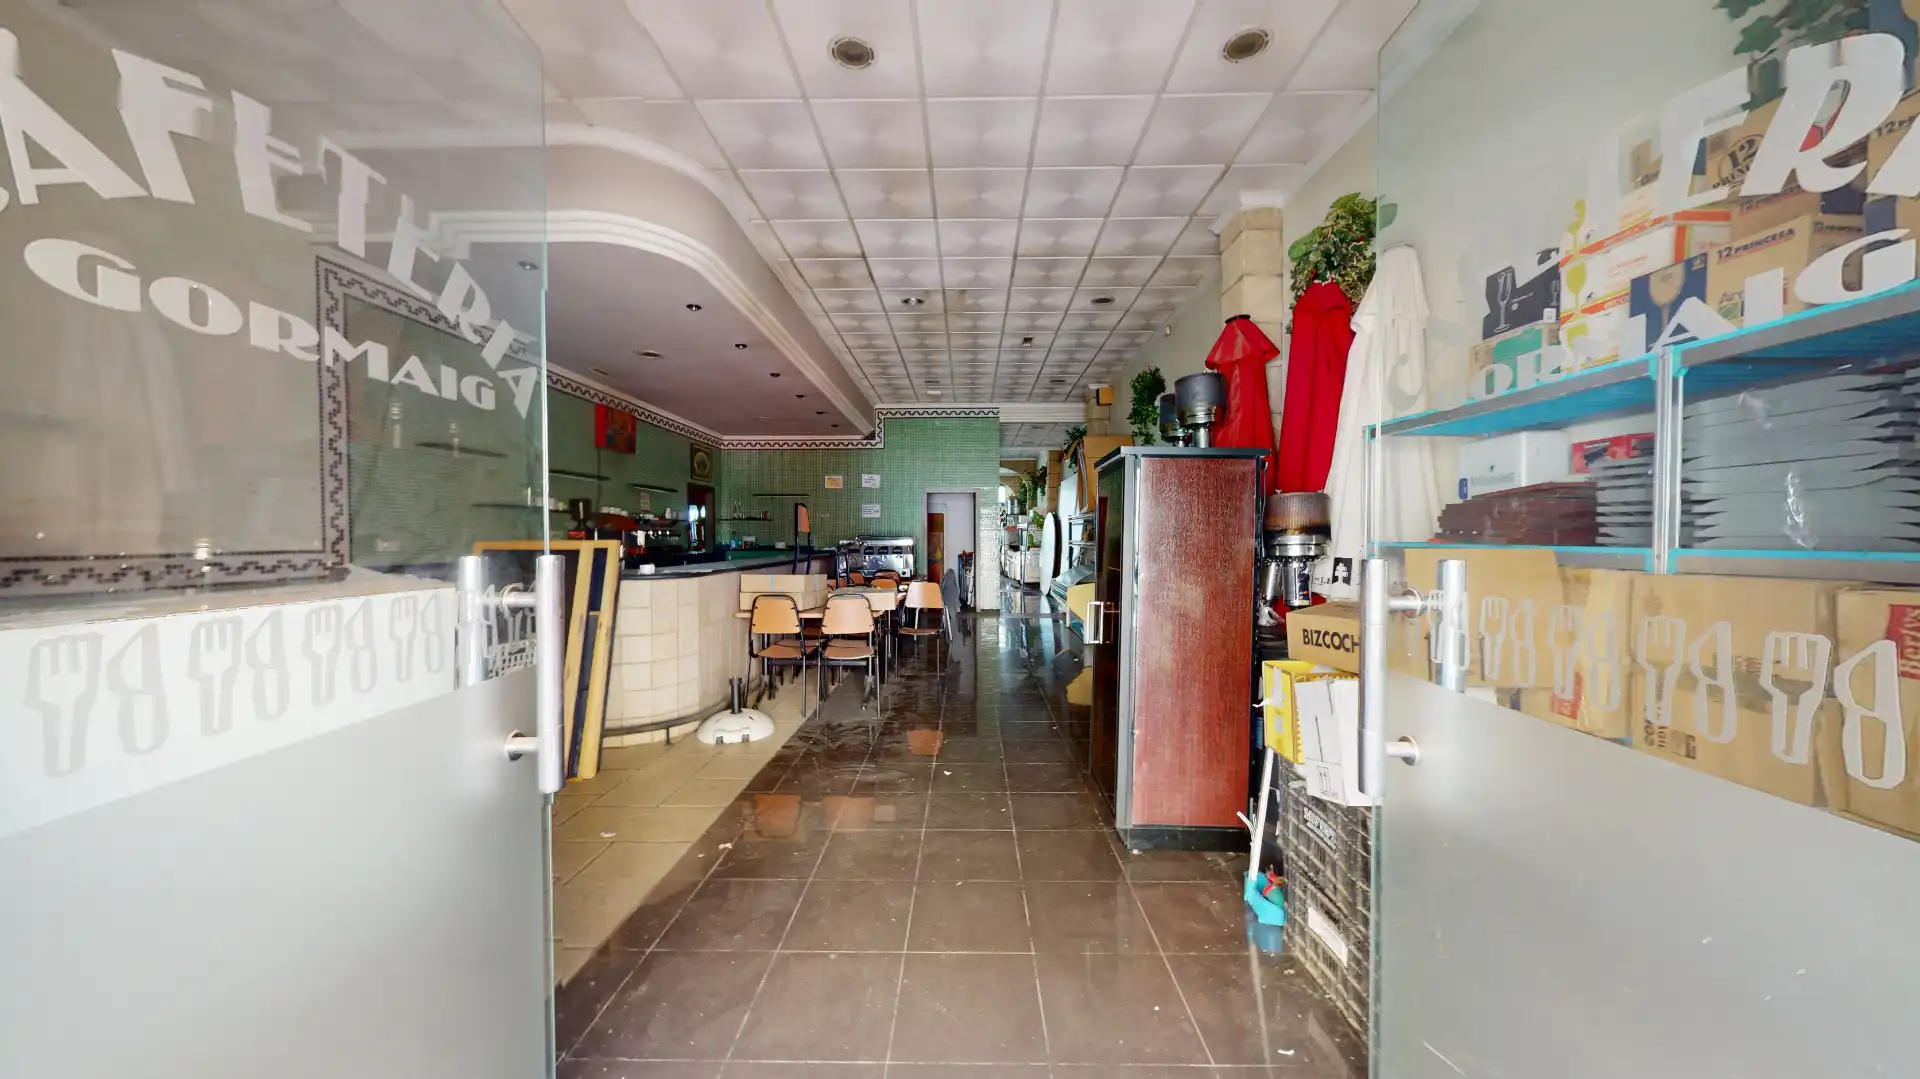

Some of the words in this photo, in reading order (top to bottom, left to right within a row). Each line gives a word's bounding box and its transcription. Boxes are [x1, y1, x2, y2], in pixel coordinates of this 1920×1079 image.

[0, 28, 539, 420] AFETERIA
[1717, 246, 1733, 262] 12
[24, 237, 497, 411] GORMAIG
